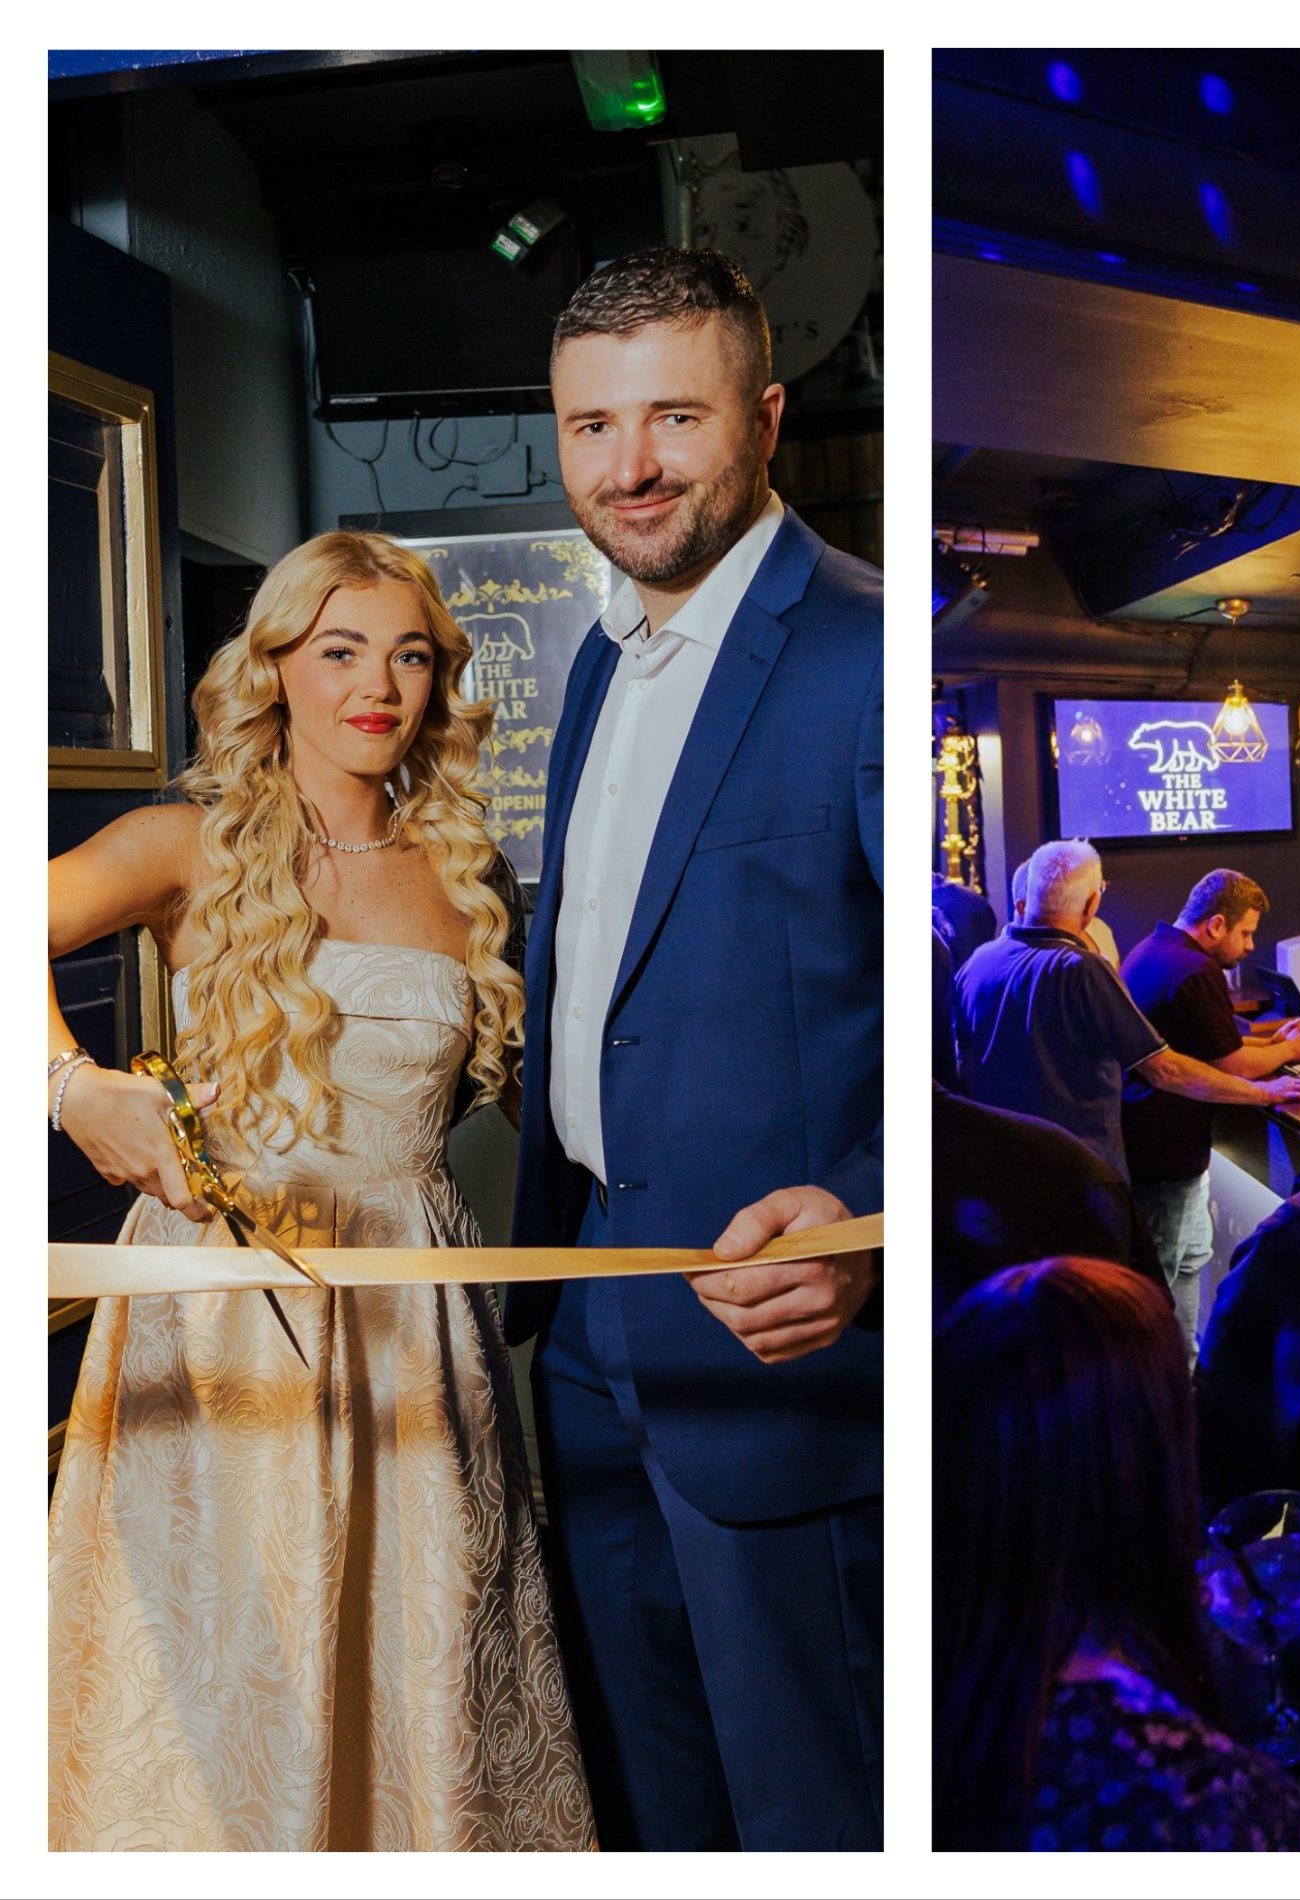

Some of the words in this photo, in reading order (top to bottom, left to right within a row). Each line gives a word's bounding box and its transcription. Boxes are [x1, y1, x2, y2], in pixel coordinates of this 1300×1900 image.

[477, 664, 513, 679] THE
[493, 700, 529, 720] AR
[1162, 774, 1203, 789] THE
[1137, 789, 1228, 811] WHITE
[1150, 811, 1218, 833] BEAR
